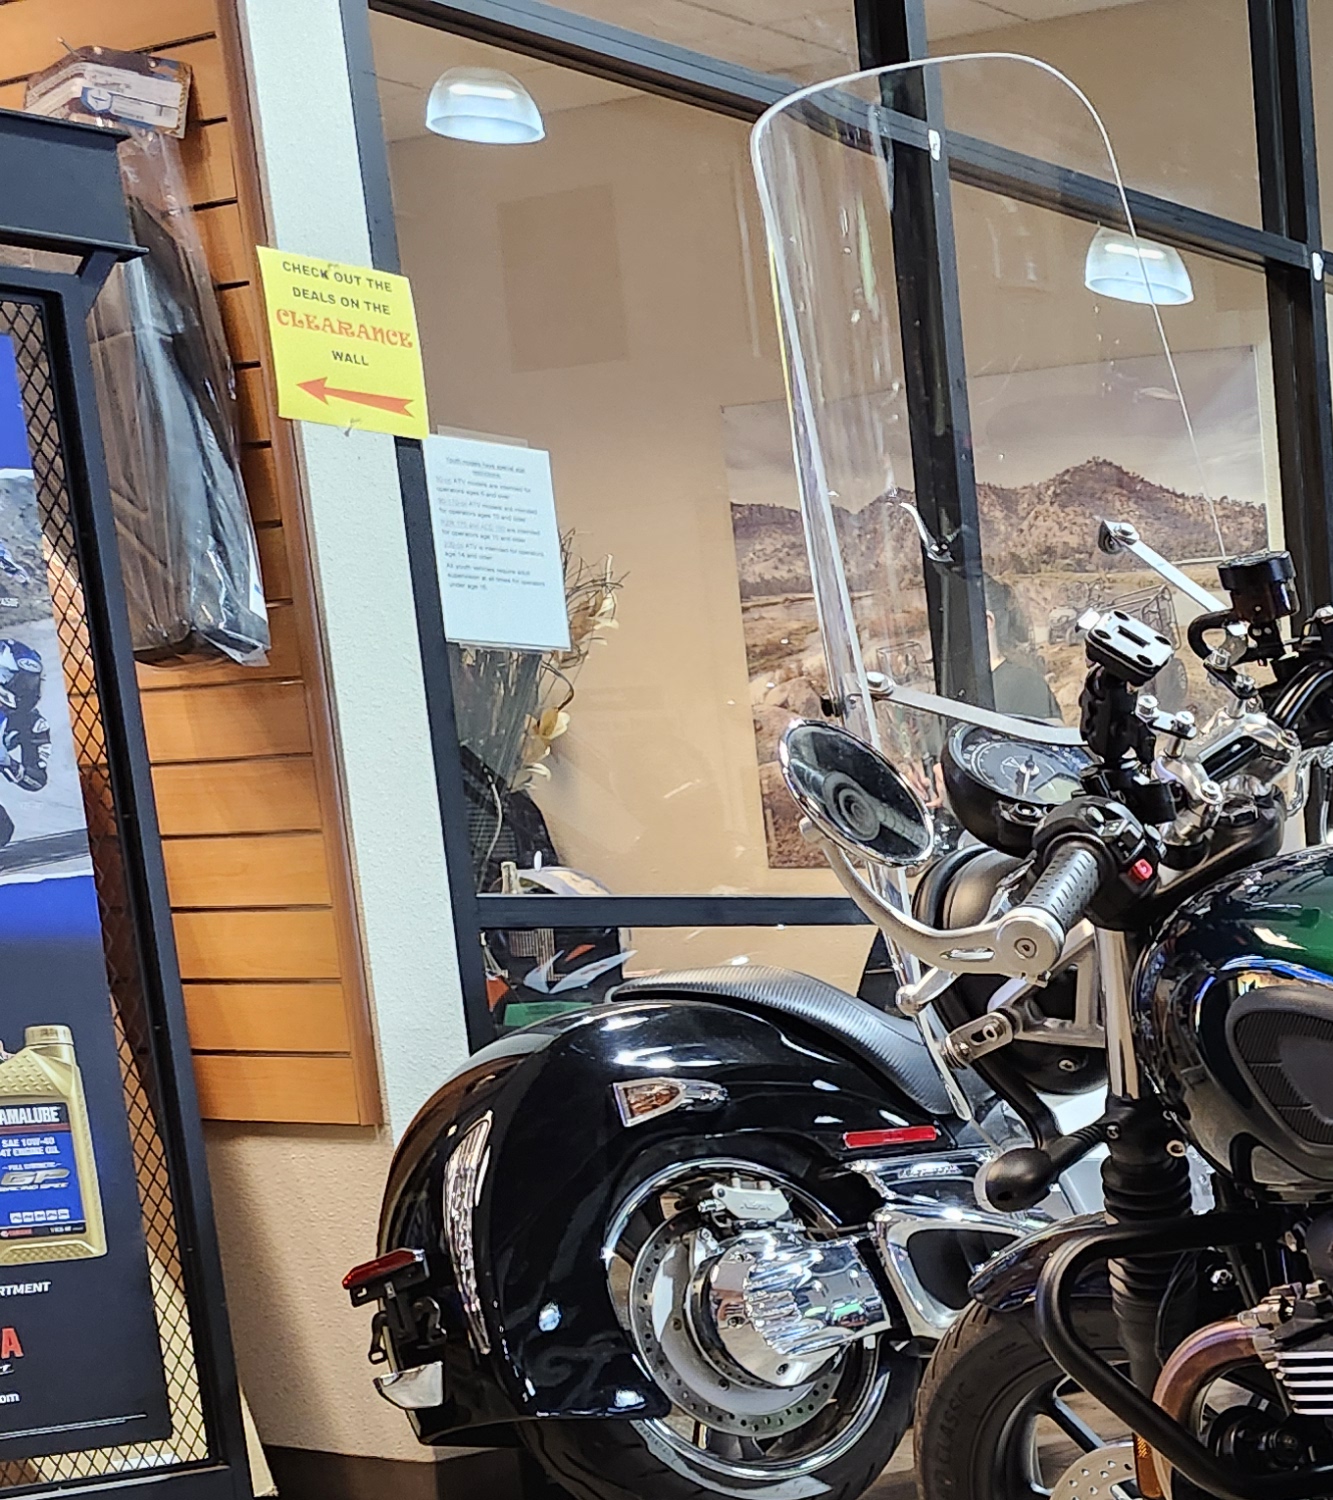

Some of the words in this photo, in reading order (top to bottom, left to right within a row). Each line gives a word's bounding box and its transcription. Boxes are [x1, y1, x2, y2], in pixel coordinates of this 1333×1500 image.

[282, 261, 329, 280] CHECK
[334, 271, 362, 287] OUT
[366, 278, 393, 293] THE
[292, 286, 336, 305] DEALS
[340, 296, 360, 310] ON
[364, 301, 391, 316] THE
[276, 308, 413, 349] CLEARANCE
[331, 350, 370, 366] WALL
[2, 1138, 20, 1148] SAE
[20, 1136, 56, 1147] 10W-40
[13, 1146, 44, 1157] ENGINE
[45, 1145, 61, 1155] OIL
